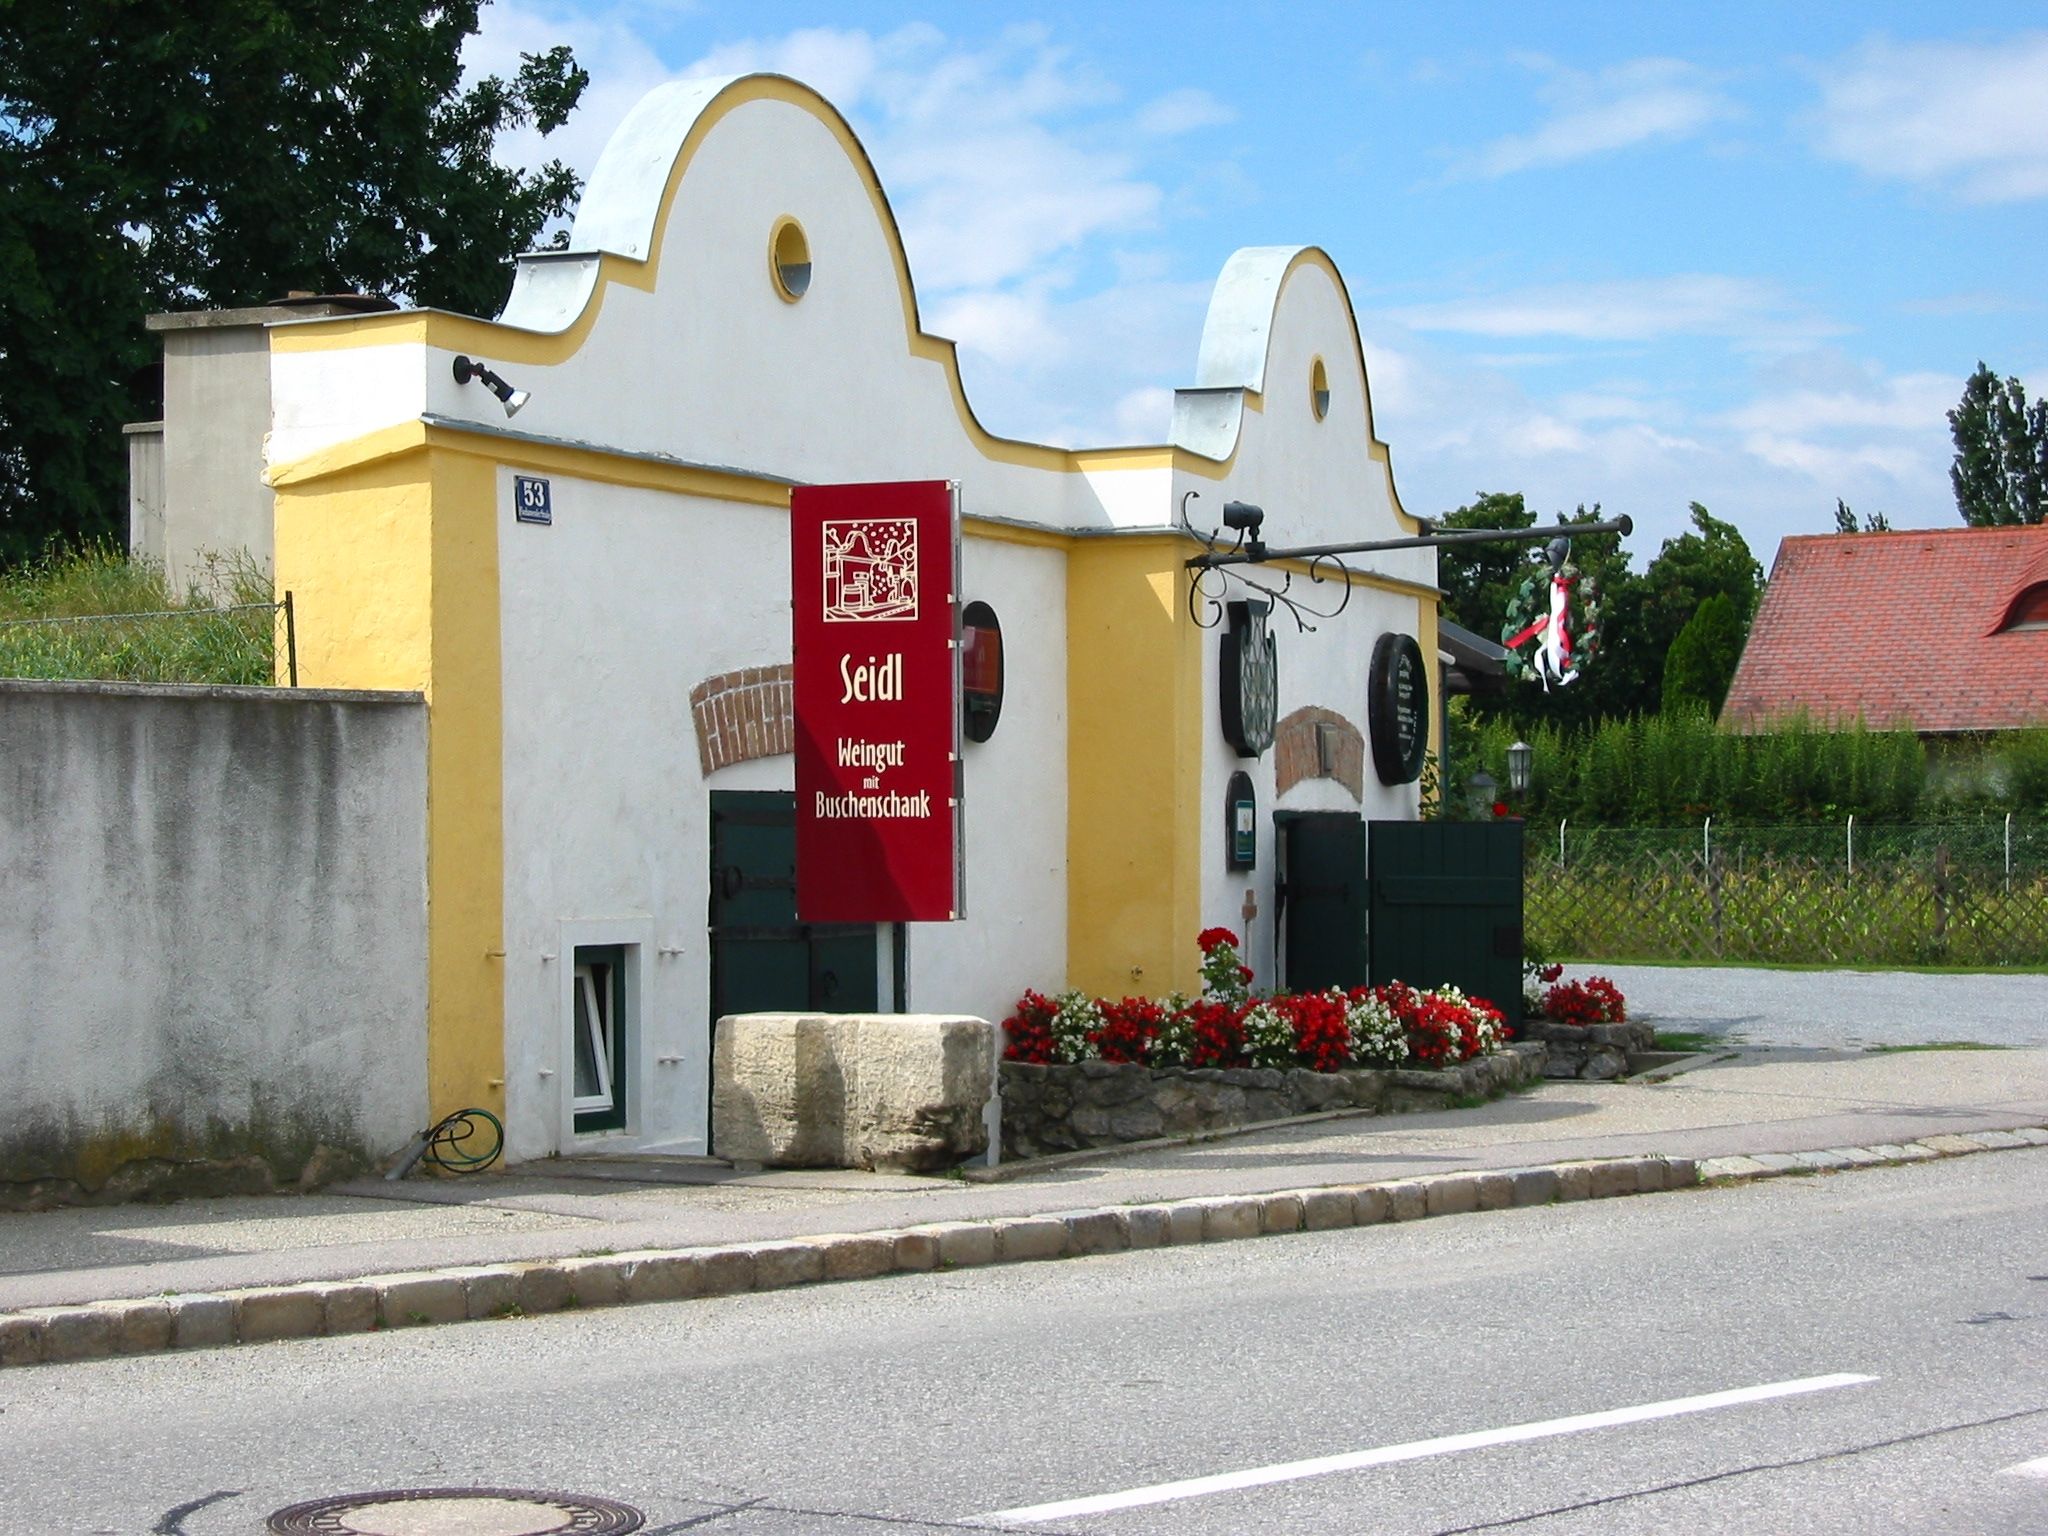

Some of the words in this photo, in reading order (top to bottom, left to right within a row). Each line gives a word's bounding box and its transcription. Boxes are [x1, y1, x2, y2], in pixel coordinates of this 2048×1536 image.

[523, 481, 545, 507] 53
[840, 653, 902, 704] Seidl
[838, 737, 905, 773] Weingut
[863, 775, 880, 789] mit
[815, 789, 931, 818] Buschenschank
